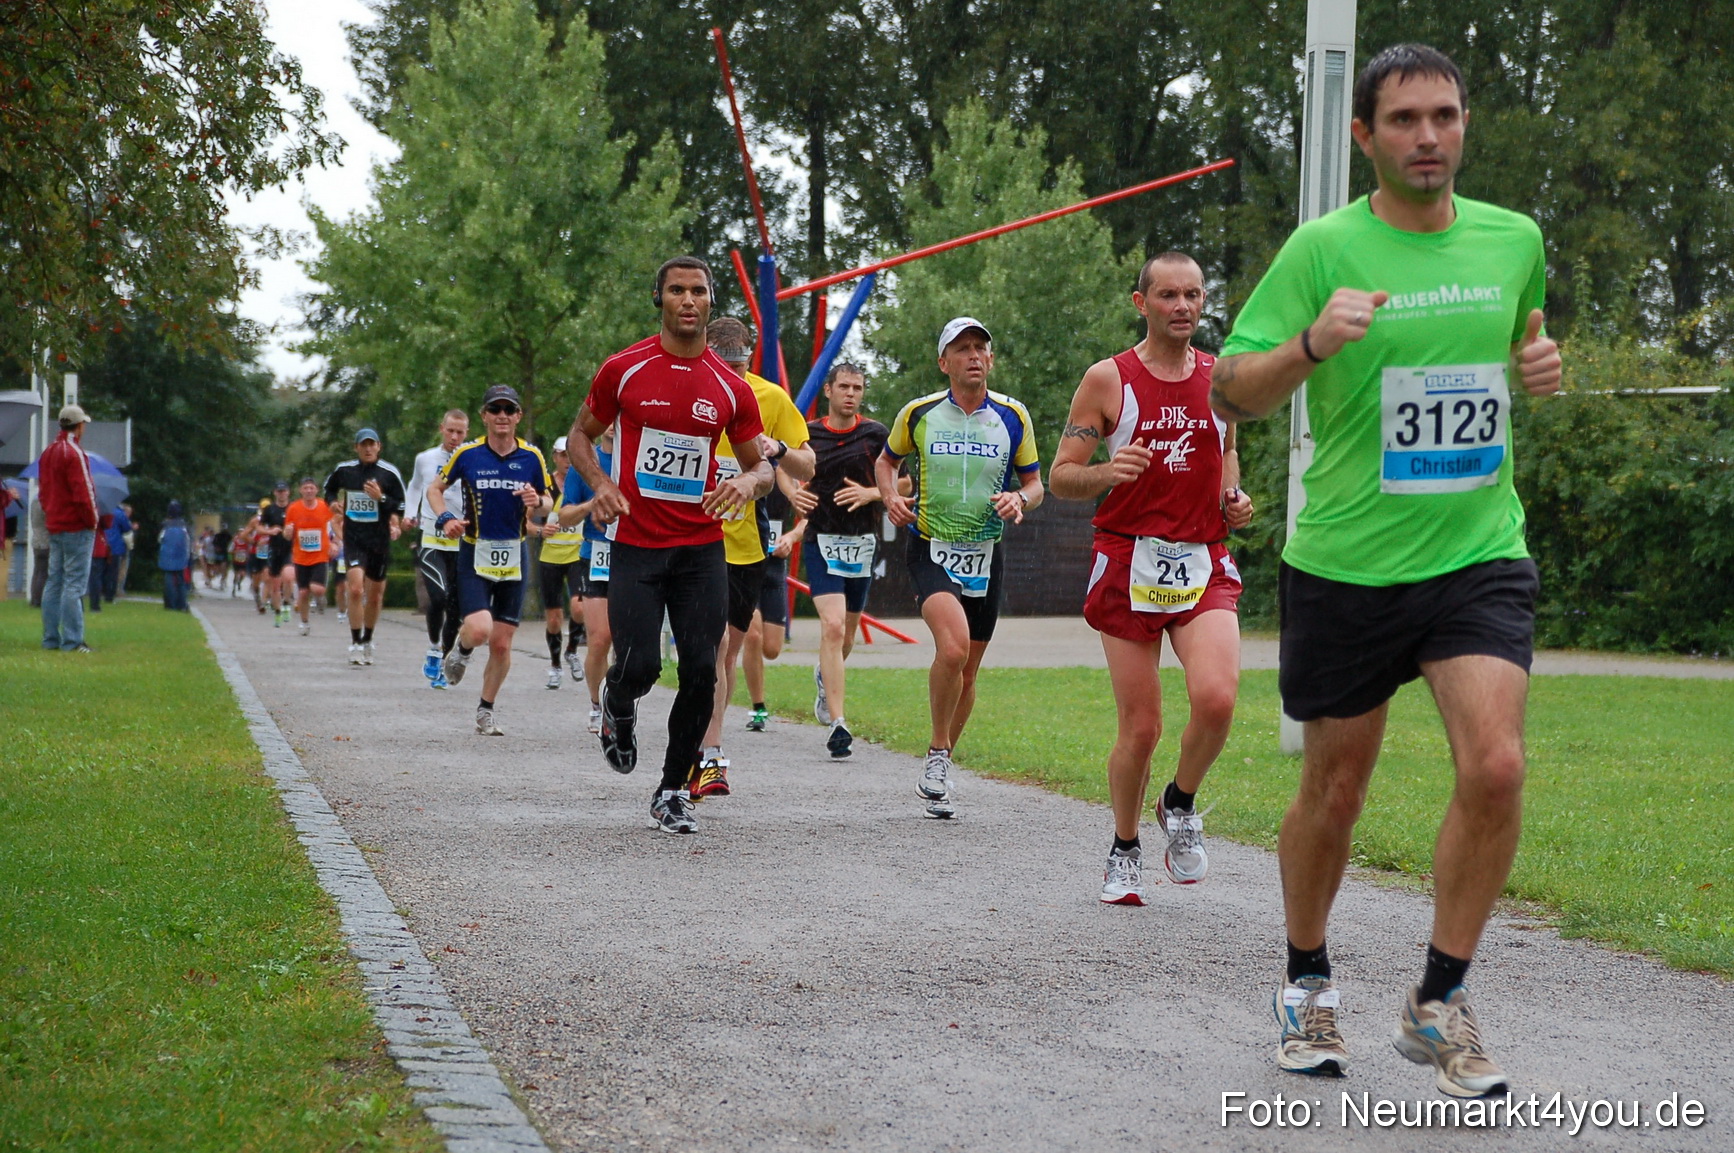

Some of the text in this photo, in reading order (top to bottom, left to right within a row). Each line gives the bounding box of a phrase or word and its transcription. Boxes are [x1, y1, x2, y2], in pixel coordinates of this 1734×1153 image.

[1425, 374, 1475, 388] BOCK
[1160, 406, 1190, 424] DJK
[1396, 398, 1499, 447] 3123
[664, 436, 694, 448] BOCK
[934, 430, 977, 441] TEAM
[930, 441, 1000, 458] BOCK
[643, 447, 703, 478] 3211
[1410, 455, 1482, 475] Christian
[476, 479, 526, 491] BOCK
[654, 479, 686, 492] Daniel
[349, 499, 375, 512] 2359
[490, 550, 510, 566] 99
[824, 545, 861, 562] 2117
[937, 550, 986, 575] 2237
[1156, 559, 1191, 587] 24
[1148, 590, 1197, 604] Christian
